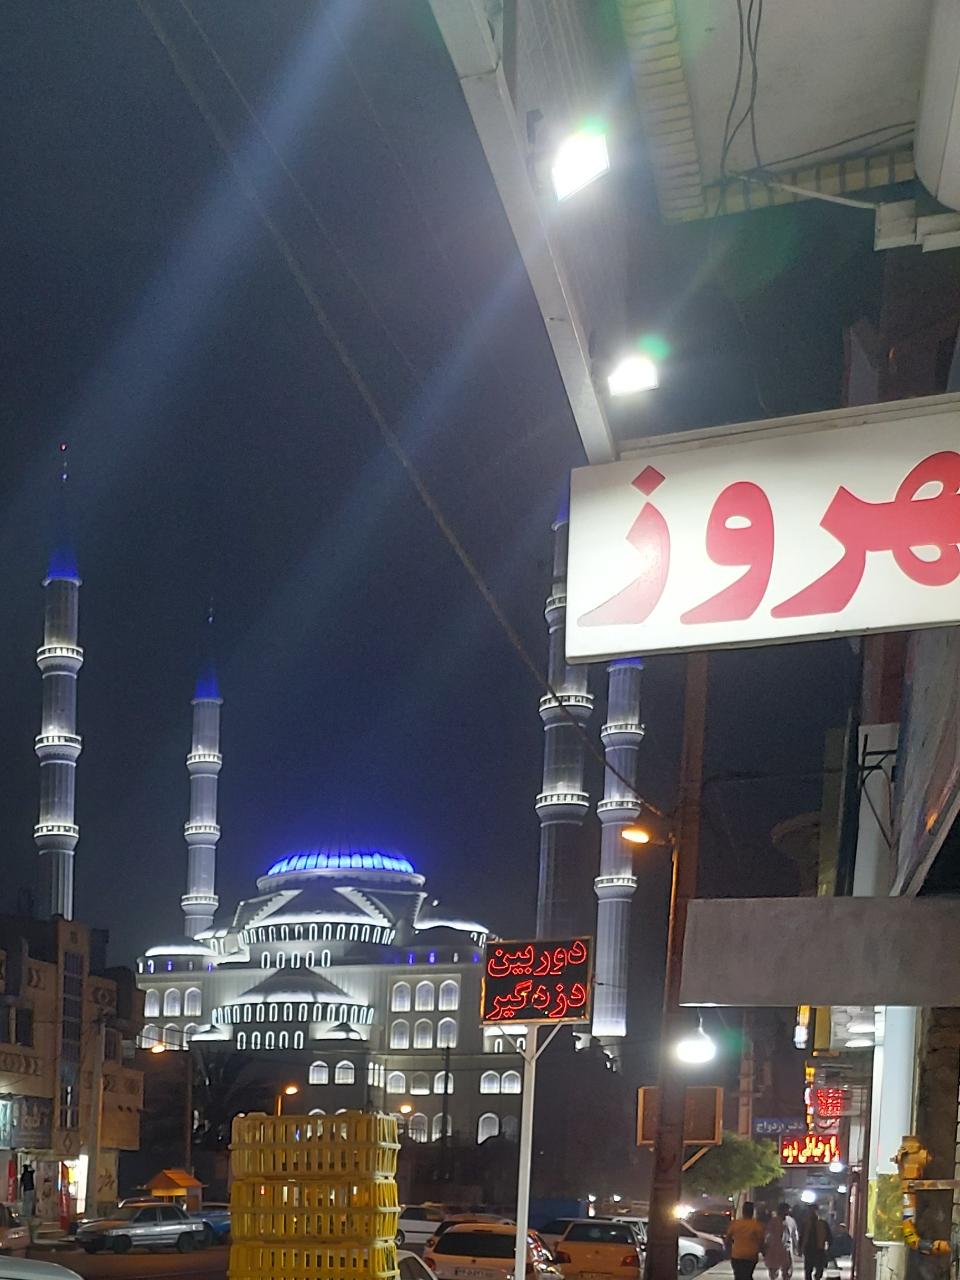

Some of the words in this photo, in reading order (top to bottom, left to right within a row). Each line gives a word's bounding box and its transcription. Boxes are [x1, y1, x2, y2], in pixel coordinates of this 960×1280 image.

[577, 450, 960, 628] هروز
[487, 940, 587, 977] دوربین
[485, 979, 586, 1020] دزدگیر
[756, 1121, 784, 1133] ازدواج
